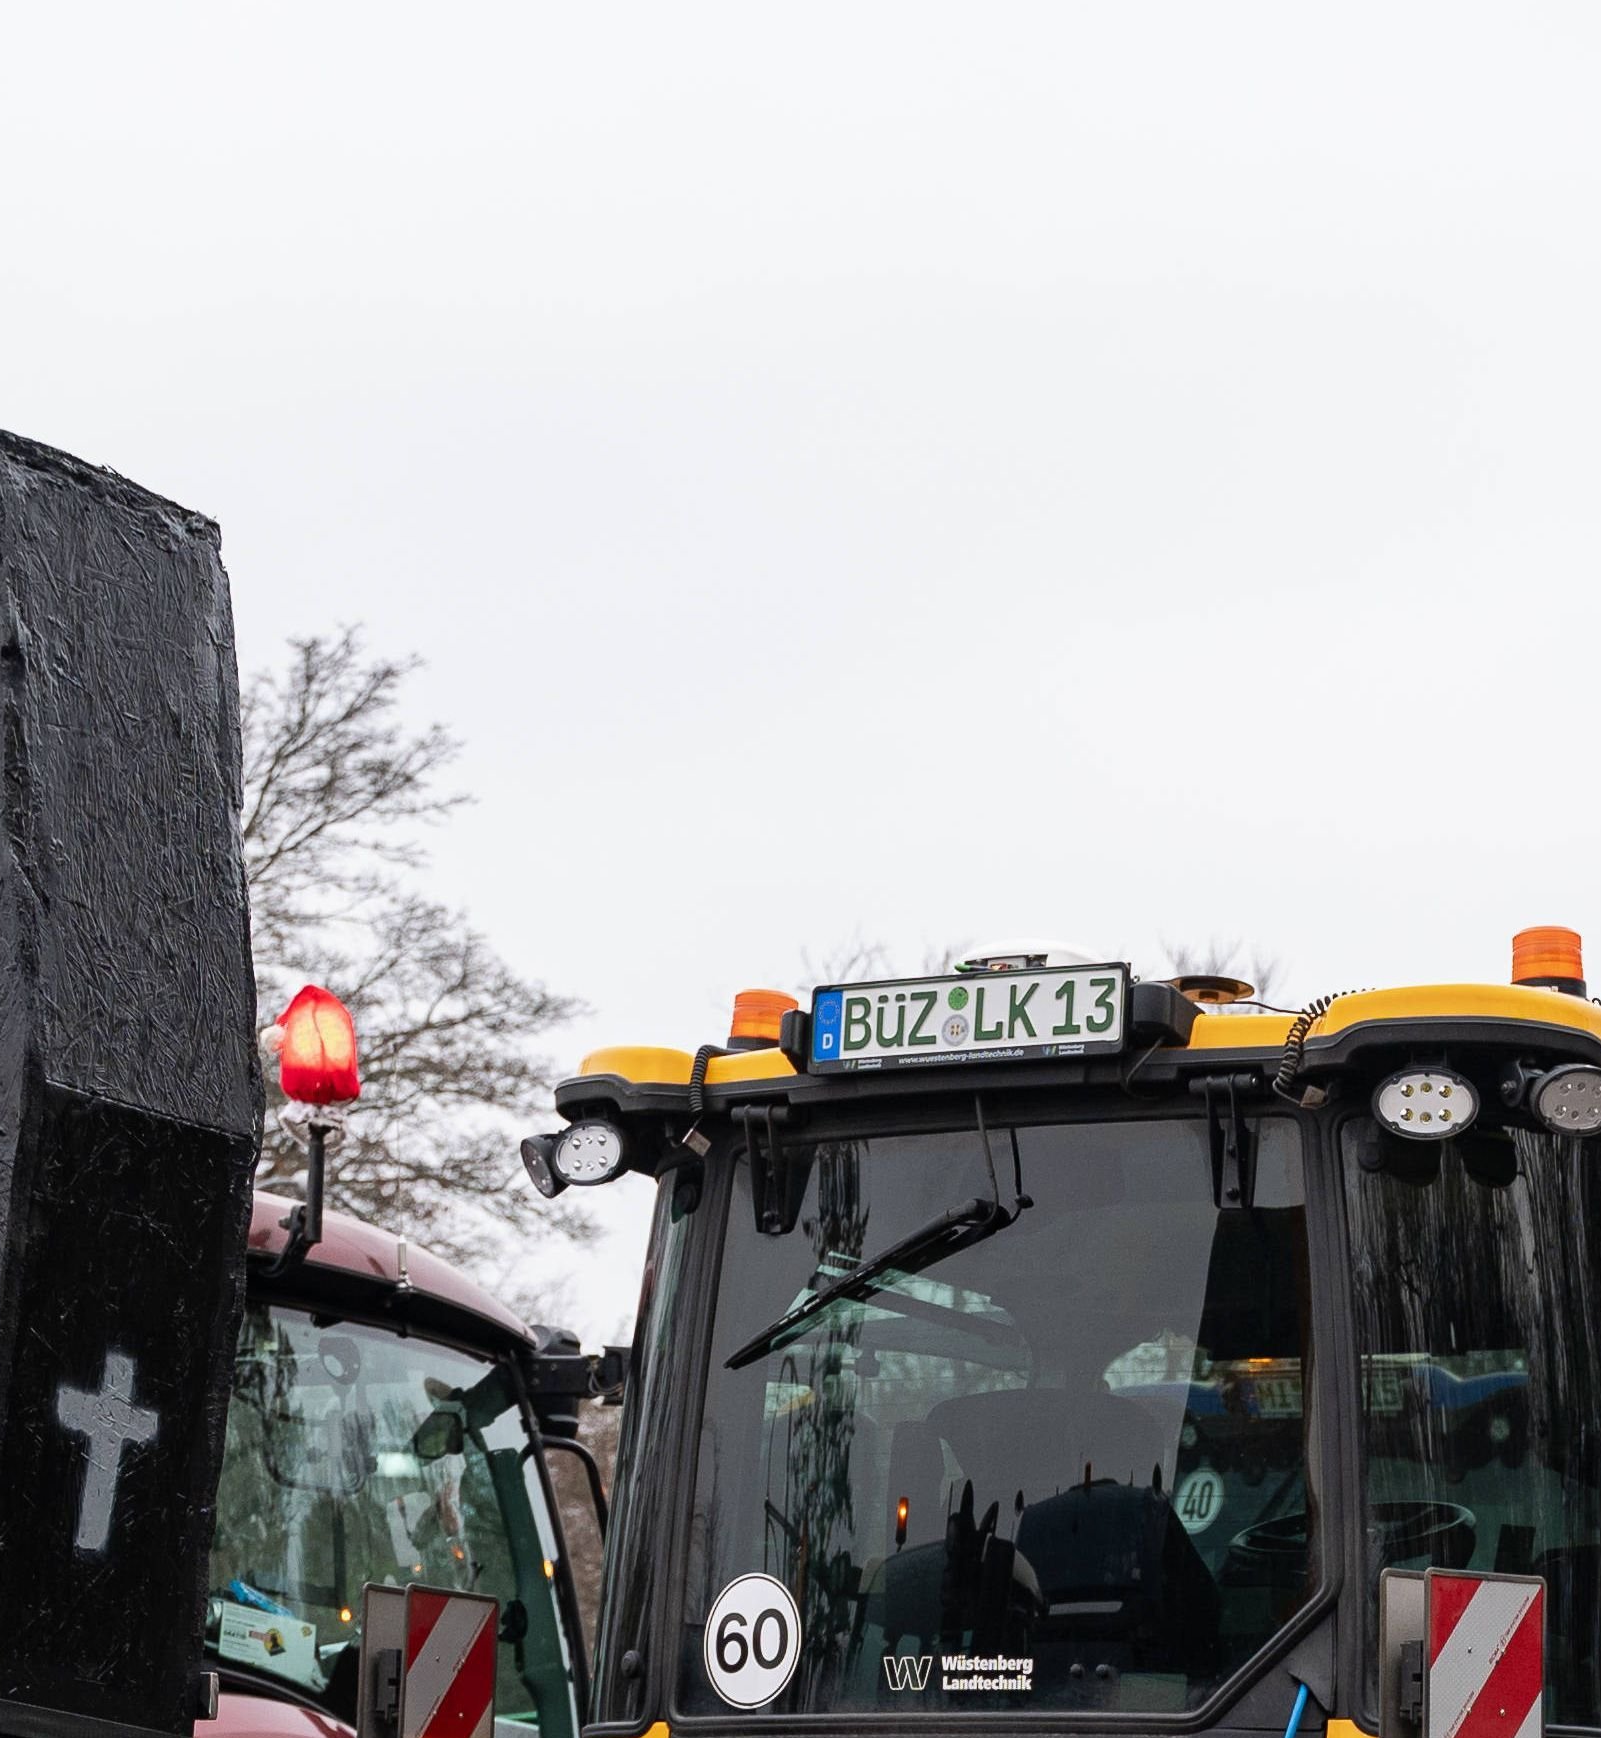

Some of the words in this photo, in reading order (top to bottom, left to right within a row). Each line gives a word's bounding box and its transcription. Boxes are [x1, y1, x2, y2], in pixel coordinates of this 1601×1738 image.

[974, 982, 1040, 1042] LK
[1052, 977, 1116, 1036] 13
[822, 1033, 833, 1050] D
[898, 1048, 1024, 1065] www.wuestenberg-landtechnik.de
[1182, 1481, 1212, 1520] 40
[714, 1606, 790, 1674] 60
[941, 1654, 1034, 1677] Wüstenberg
[942, 1675, 1032, 1691] Landtechnik
